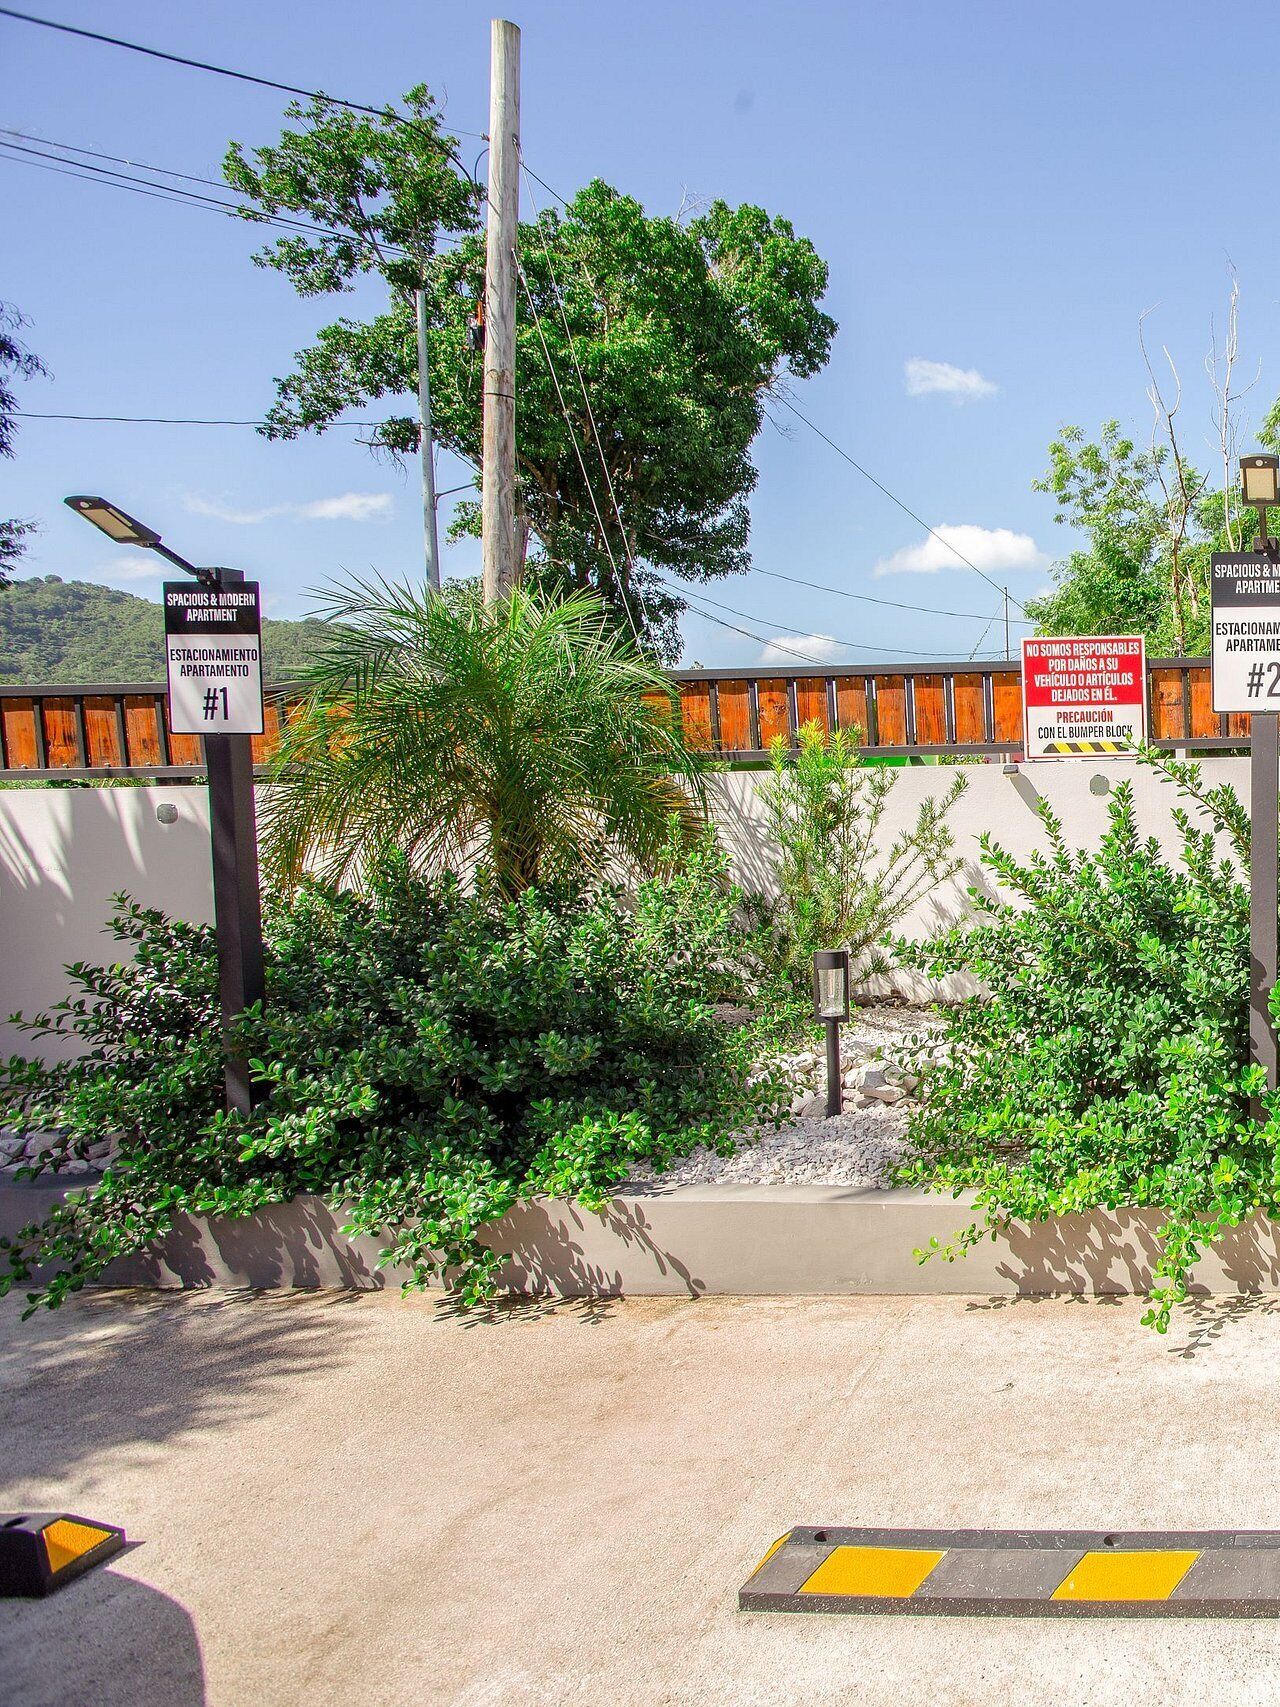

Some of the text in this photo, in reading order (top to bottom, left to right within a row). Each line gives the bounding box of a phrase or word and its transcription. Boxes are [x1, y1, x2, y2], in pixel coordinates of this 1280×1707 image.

[1215, 564, 1261, 578] SPACIOUS
[1263, 564, 1270, 577] &
[167, 594, 255, 606] SPACIOUS & MODERN
[187, 609, 237, 622] APARTMENT
[170, 649, 258, 661] ESTACIONAMIENTO
[1027, 642, 1139, 656] NO SOMOS RESPONSABLES
[1049, 656, 1118, 671] POR DAÑOS A SU
[180, 665, 249, 677] APARTAMENTO
[1034, 671, 1133, 687] VEHÍCULO O ARTÍCULOS
[1052, 686, 1117, 702] DEJADOS EN ÉL.
[203, 687, 228, 720] #1
[1057, 708, 1113, 723] PRECAUCIÓN
[1038, 727, 1055, 739] CON
[1058, 726, 1068, 738] EL
[1069, 726, 1103, 738] BUMPER
